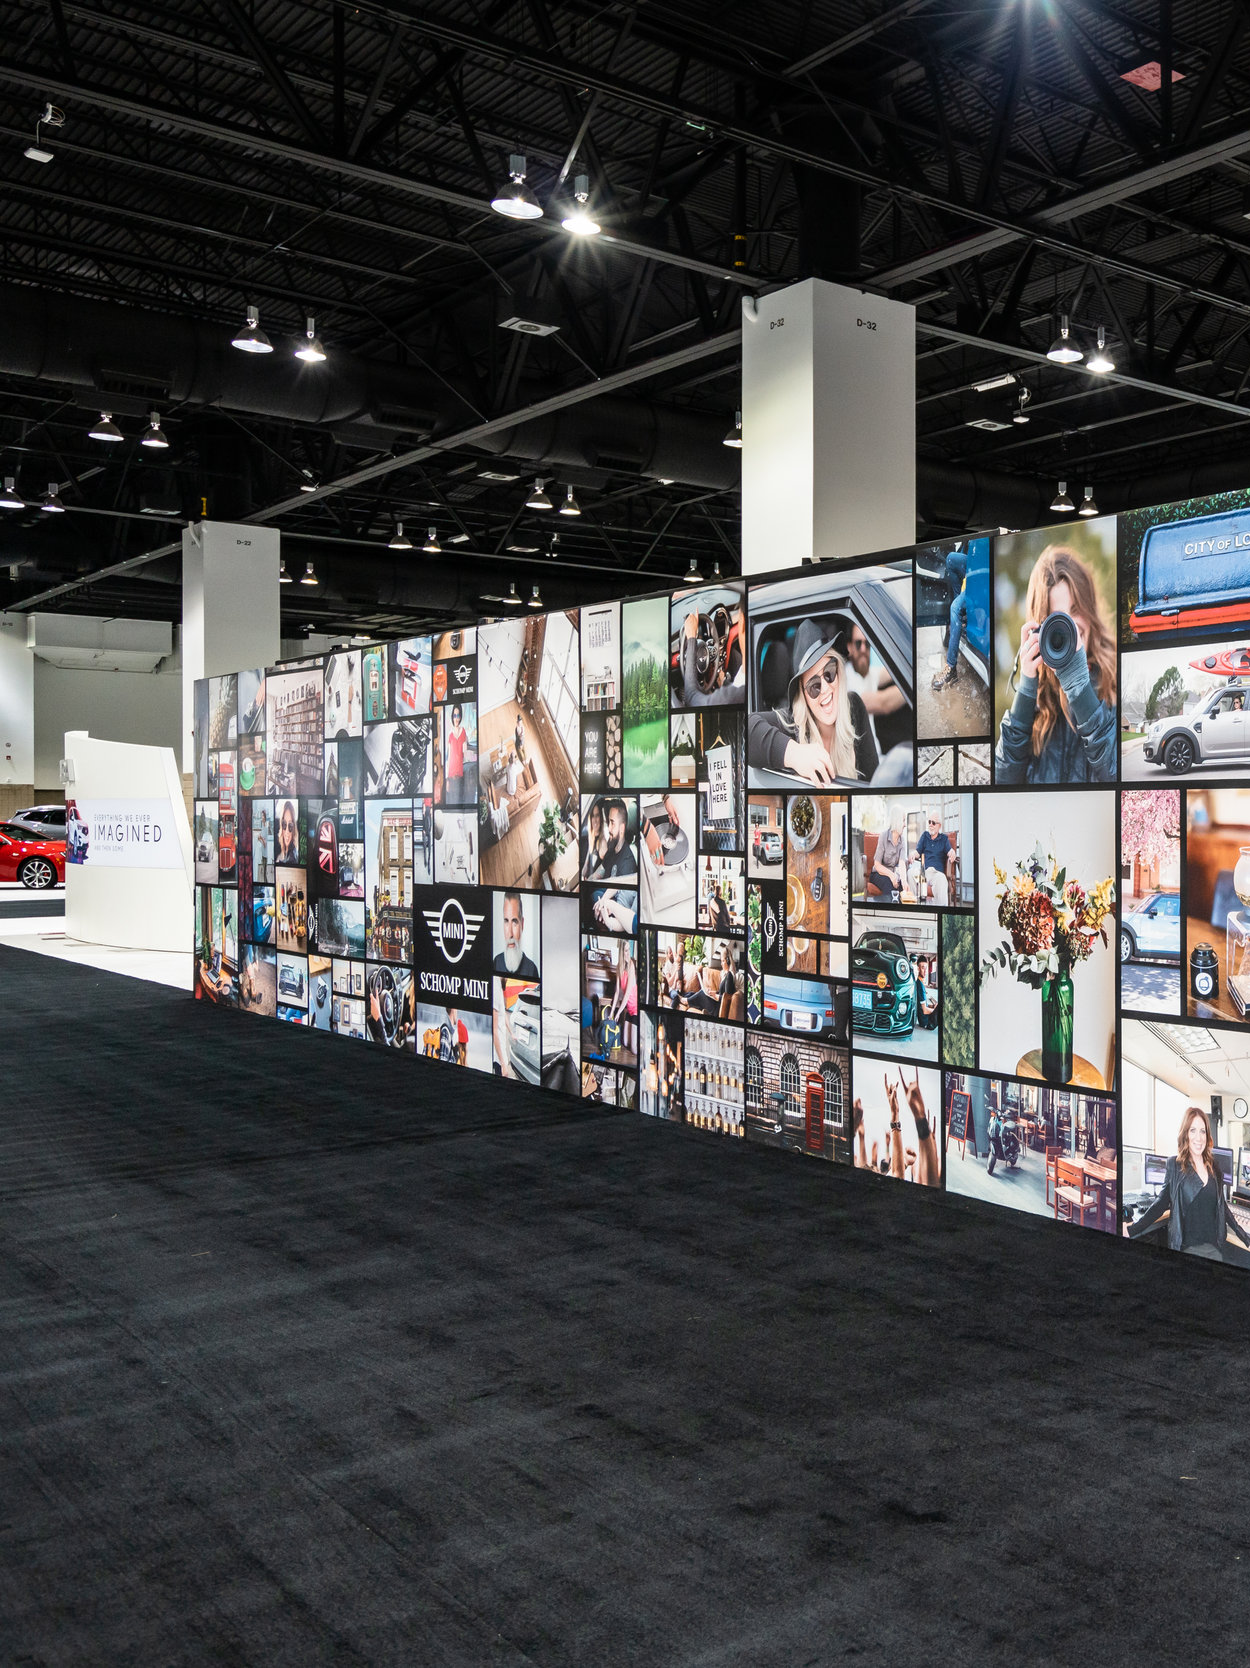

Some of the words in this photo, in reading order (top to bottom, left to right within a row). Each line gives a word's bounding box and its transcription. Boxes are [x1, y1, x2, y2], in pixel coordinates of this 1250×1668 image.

[770, 318, 784, 329] D-32
[856, 319, 877, 331] D-32
[1184, 540, 1215, 555] CITY
[1217, 540, 1231, 550] OF
[584, 731, 599, 742] YOU
[584, 747, 598, 758] ARE
[584, 763, 602, 774] HERE
[713, 760, 727, 771] FELL
[715, 772, 722, 781] IN
[712, 782, 727, 793] LOVE
[712, 793, 728, 804] HERE
[94, 814, 123, 822] EVERYTHING
[125, 814, 133, 822] WE
[135, 814, 151, 822] EVER
[94, 824, 162, 842] IMAGINED
[443, 922, 463, 940] MINI
[420, 971, 461, 995] SCHOMP
[463, 977, 489, 1000] MINI
